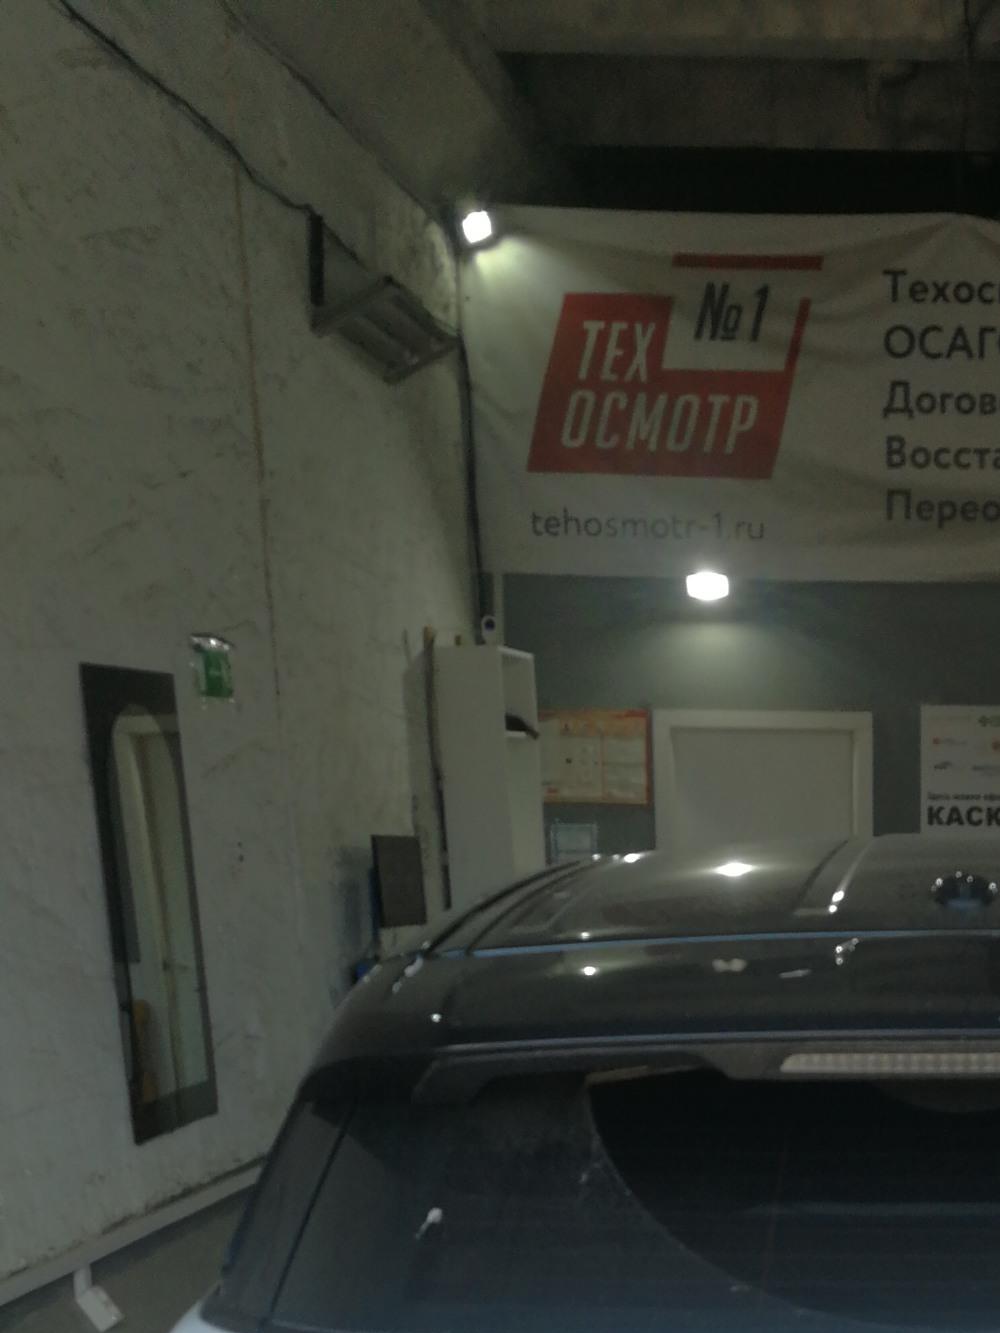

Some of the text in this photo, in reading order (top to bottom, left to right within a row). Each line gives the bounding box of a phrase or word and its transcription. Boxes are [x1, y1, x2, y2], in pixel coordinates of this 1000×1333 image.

[578, 320, 656, 382] ТЕХ
[560, 388, 759, 454] ОСМОТР
[531, 508, 765, 540] tehosmotr-1.ru
